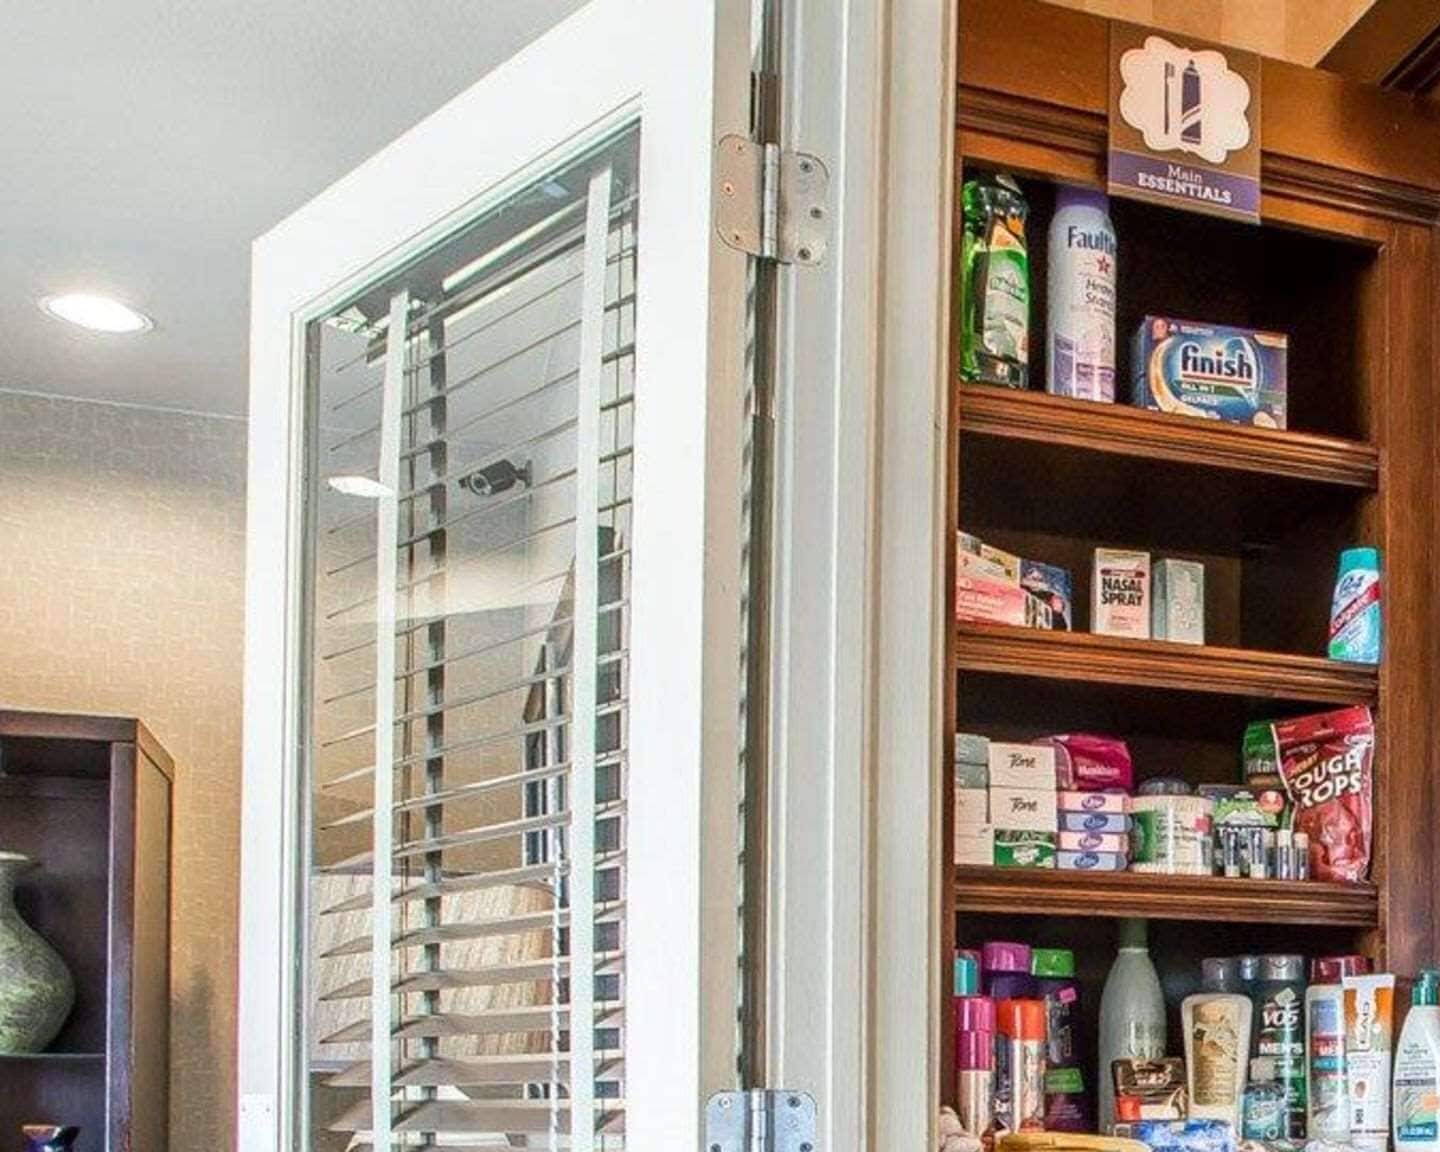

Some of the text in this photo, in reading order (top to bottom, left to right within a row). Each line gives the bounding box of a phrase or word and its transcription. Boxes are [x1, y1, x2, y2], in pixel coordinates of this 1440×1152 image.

[1167, 164, 1203, 183] Main
[1137, 172, 1233, 205] ESSENTIALS
[1180, 344, 1253, 380] finish
[1101, 577, 1143, 593] NASAL
[1100, 590, 1144, 607] SPRAY
[1007, 752, 1036, 770] Tone
[1288, 749, 1362, 790] OUGH
[1008, 796, 1039, 814] Tone
[1262, 1009, 1299, 1027] VO5
